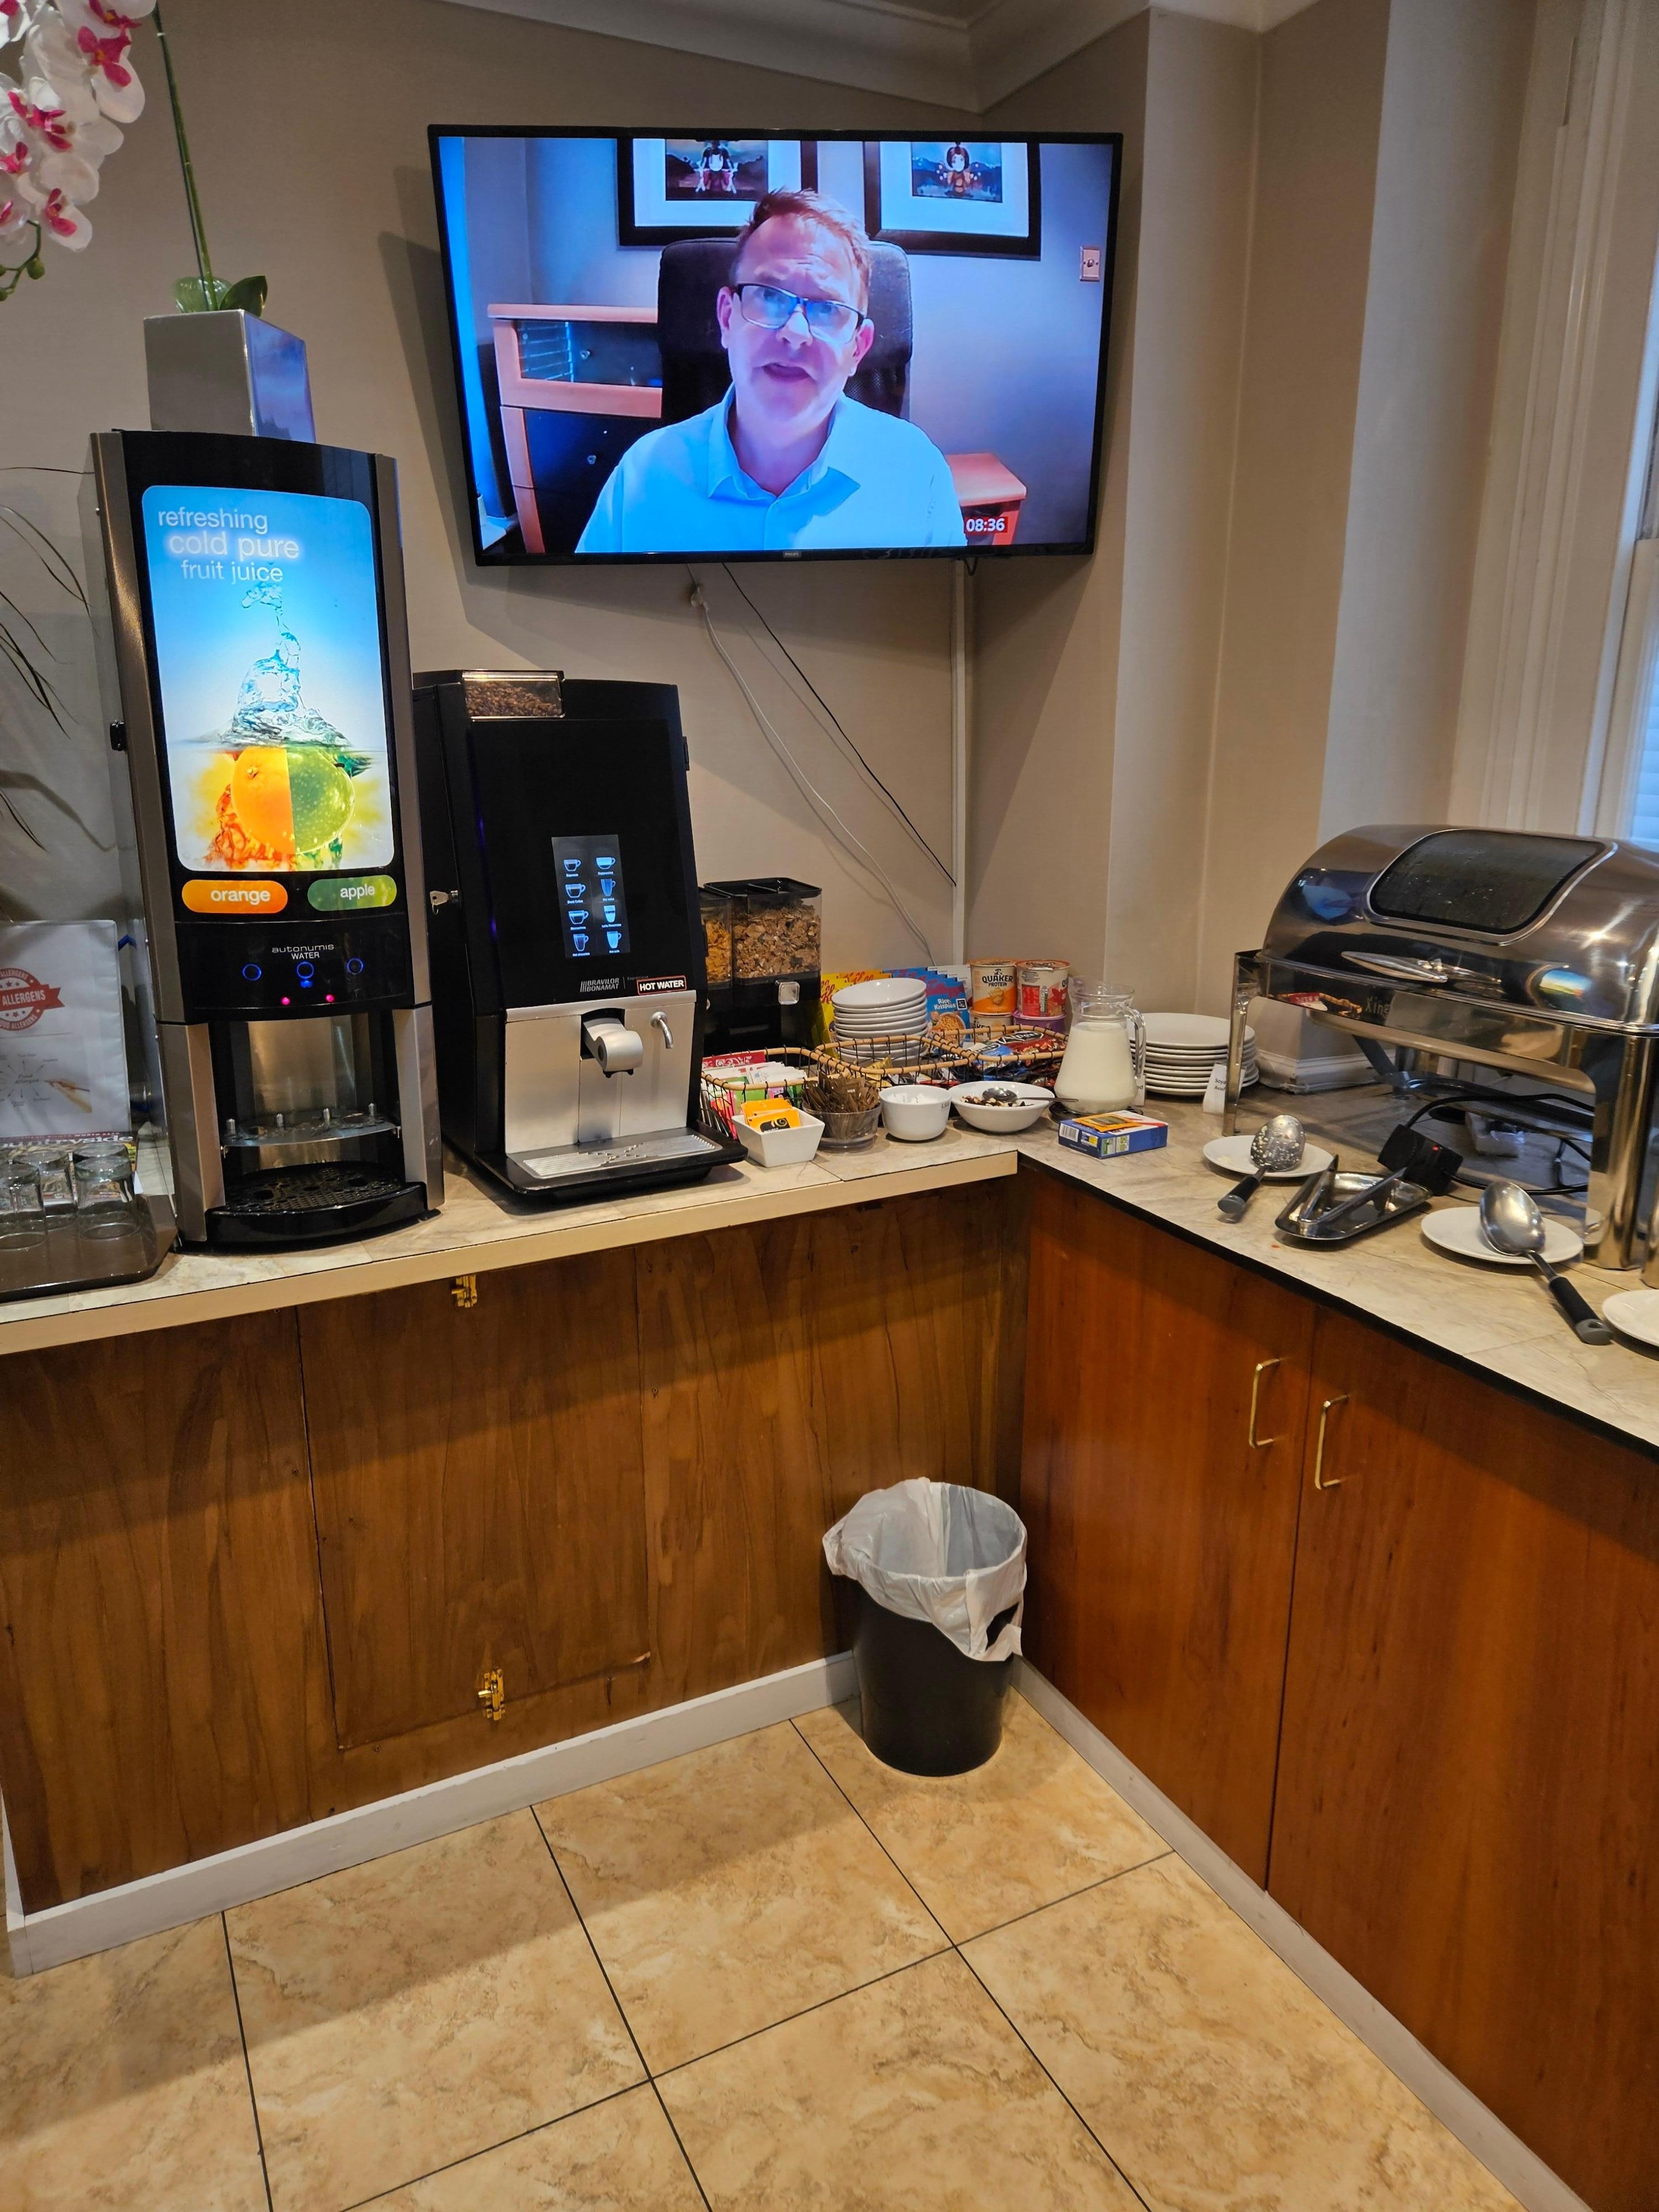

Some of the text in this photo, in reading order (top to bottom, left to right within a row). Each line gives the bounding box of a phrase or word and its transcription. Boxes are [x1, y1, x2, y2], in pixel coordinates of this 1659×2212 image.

[158, 507, 268, 535] refreshing
[966, 518, 1005, 532] 08:36
[169, 530, 300, 561] cold pure
[181, 560, 284, 585] fruit juice
[211, 888, 271, 905] orange
[340, 884, 375, 900] apple
[272, 944, 335, 953] autonumis
[291, 952, 320, 960] WATER
[587, 978, 619, 986] BRAVILOR
[639, 979, 685, 991] HOT WATER
[982, 975, 1013, 984] QUAKER
[587, 984, 619, 992] BONAMAT
[2, 989, 46, 1006] ALLERGENS
